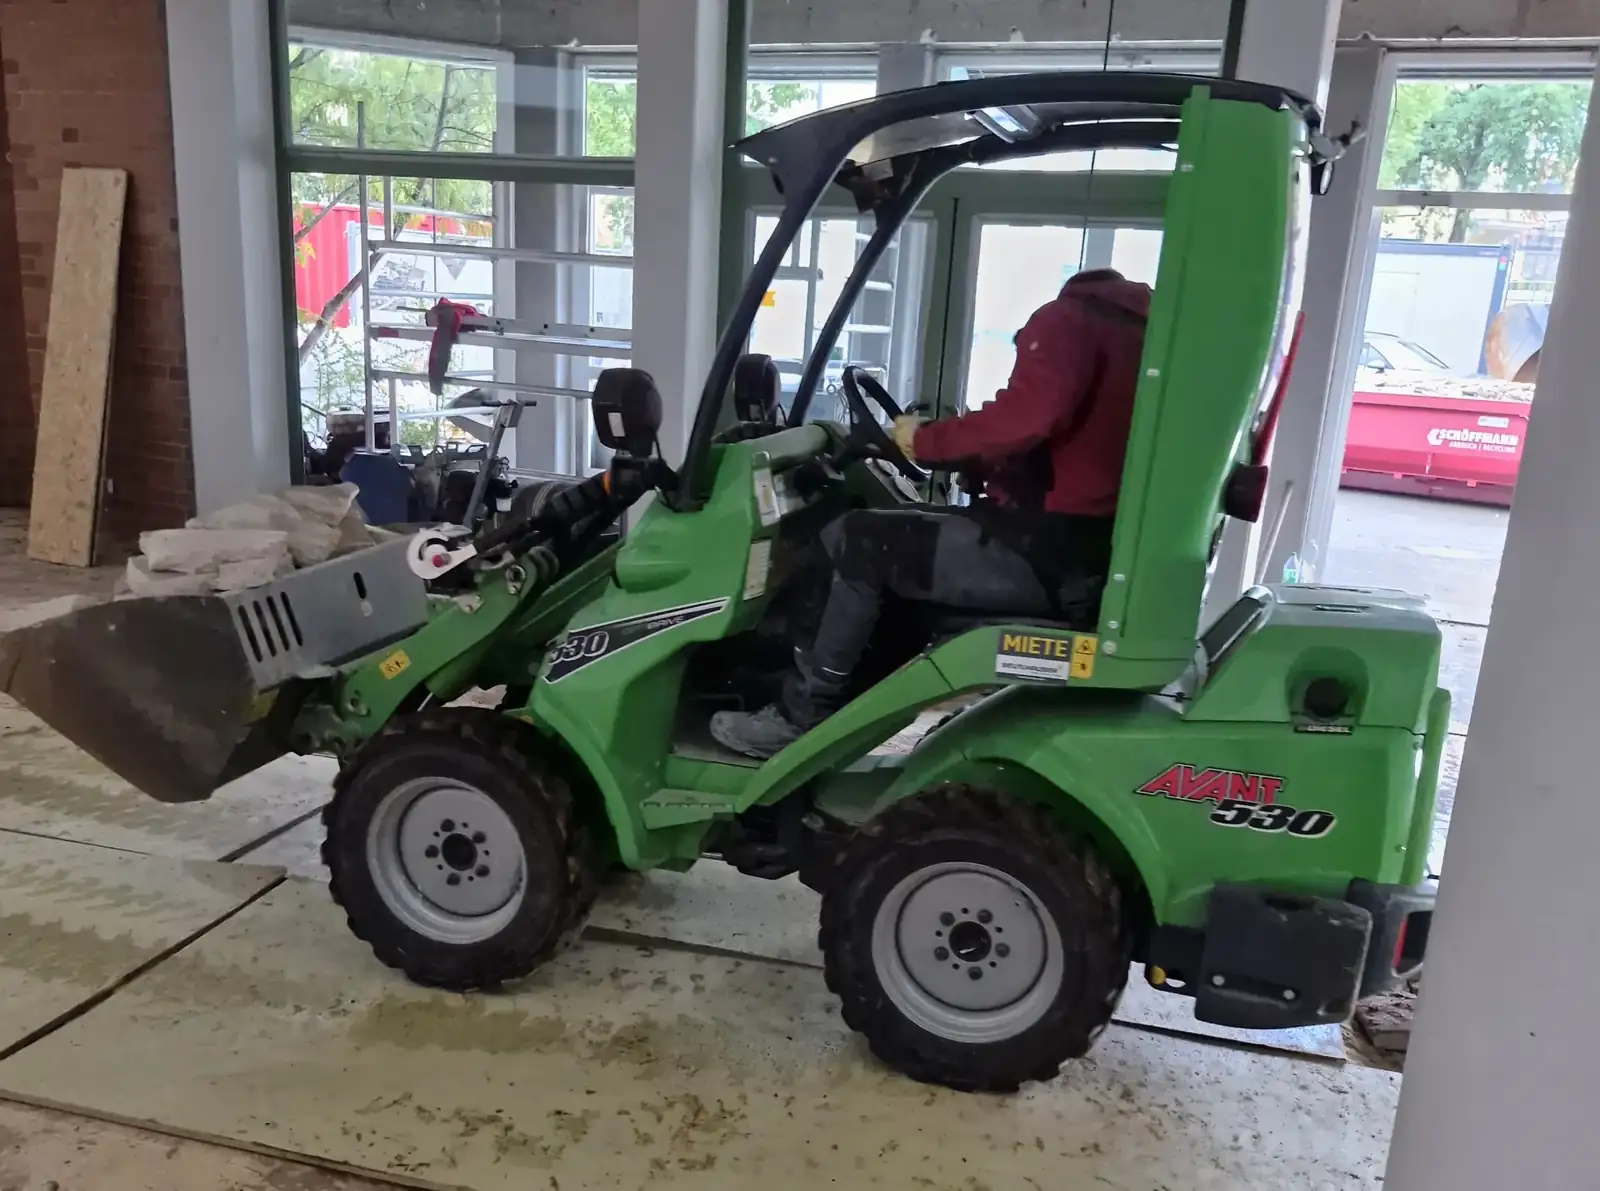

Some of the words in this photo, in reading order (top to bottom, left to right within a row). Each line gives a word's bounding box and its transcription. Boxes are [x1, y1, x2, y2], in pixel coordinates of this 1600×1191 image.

[1438, 429, 1518, 446] SCHÖFFMANN
[1003, 633, 1068, 657] MIETE
[1136, 763, 1286, 805] AVANT
[1209, 799, 1337, 838] 530
